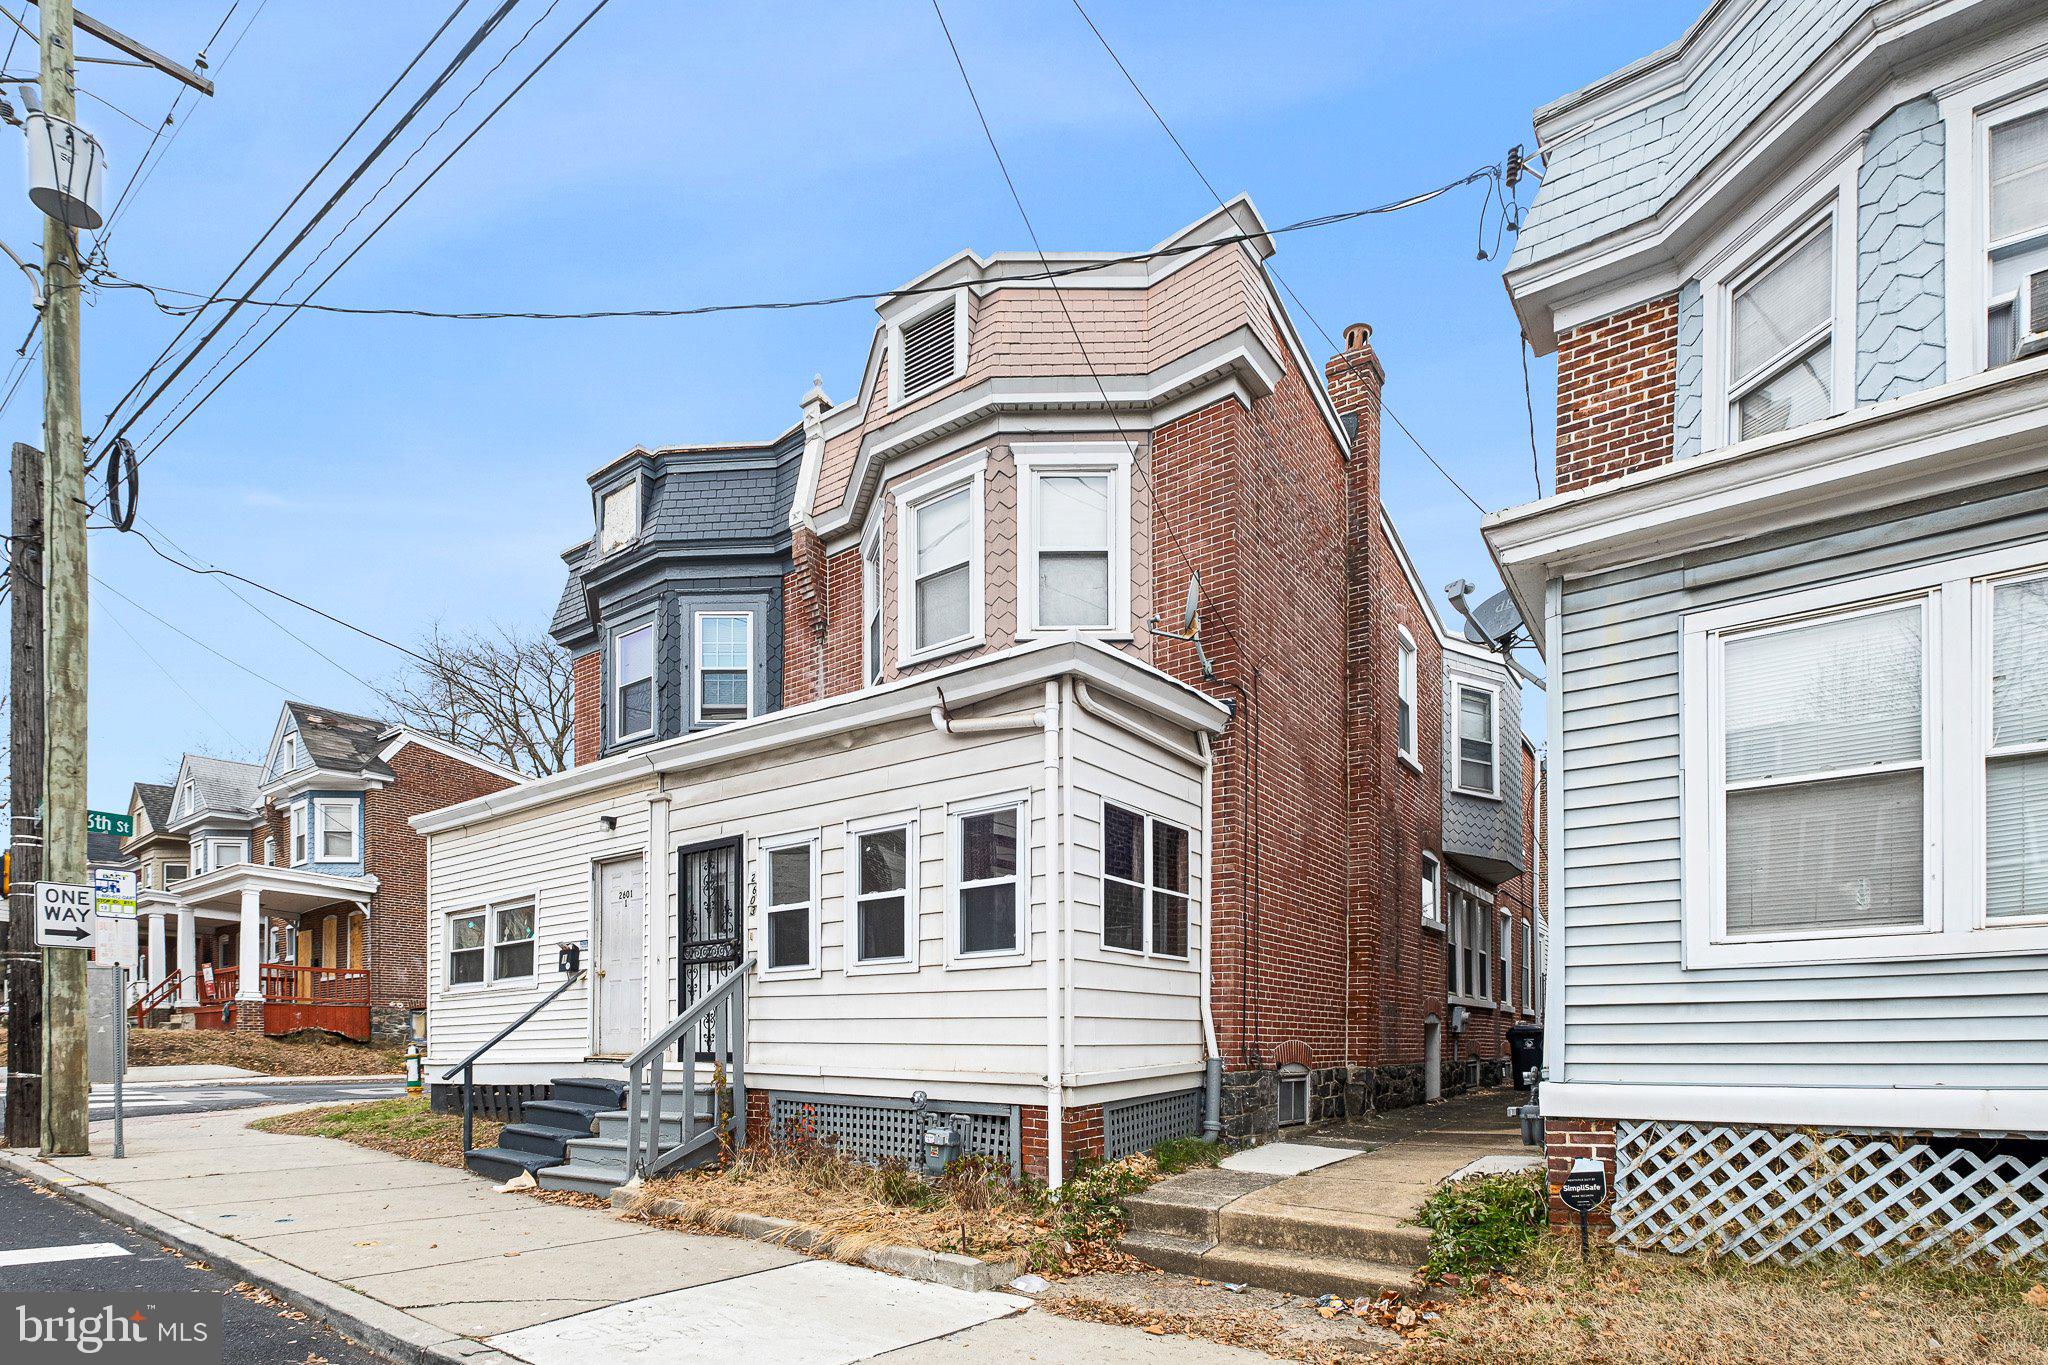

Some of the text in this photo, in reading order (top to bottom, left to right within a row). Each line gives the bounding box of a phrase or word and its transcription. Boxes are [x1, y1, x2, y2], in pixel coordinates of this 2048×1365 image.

[116, 820, 130, 833] St
[46, 888, 89, 905] ONE
[618, 889, 633, 899] 2601
[44, 905, 91, 922] WAY
[1563, 1184, 1601, 1192] SimpliSafe
